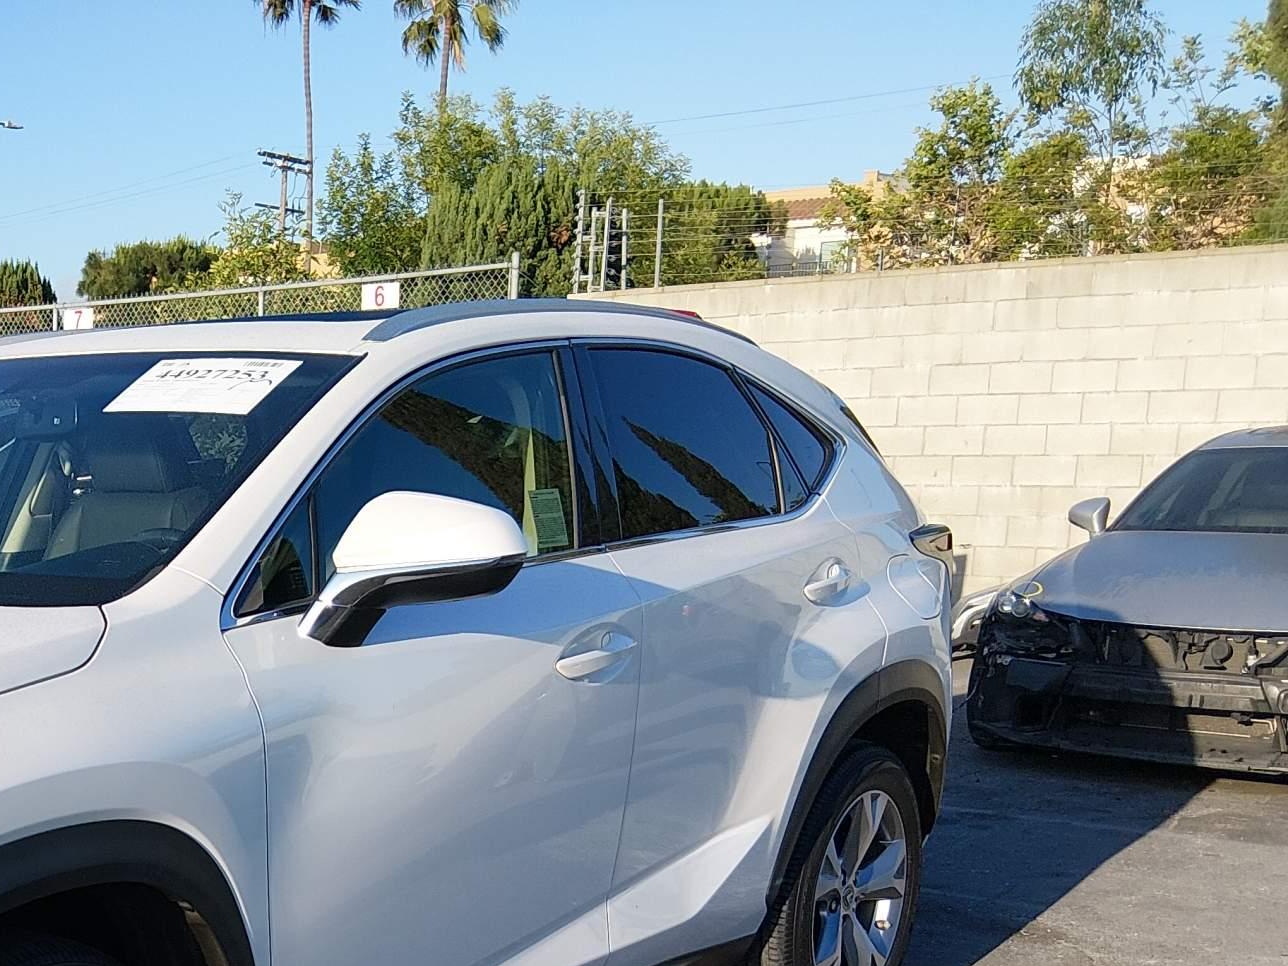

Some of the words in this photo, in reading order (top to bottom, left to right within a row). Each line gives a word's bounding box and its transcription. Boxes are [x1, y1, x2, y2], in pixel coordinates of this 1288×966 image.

[375, 285, 384, 307] 6
[74, 310, 83, 329] 7
[155, 368, 270, 382] 44927253
